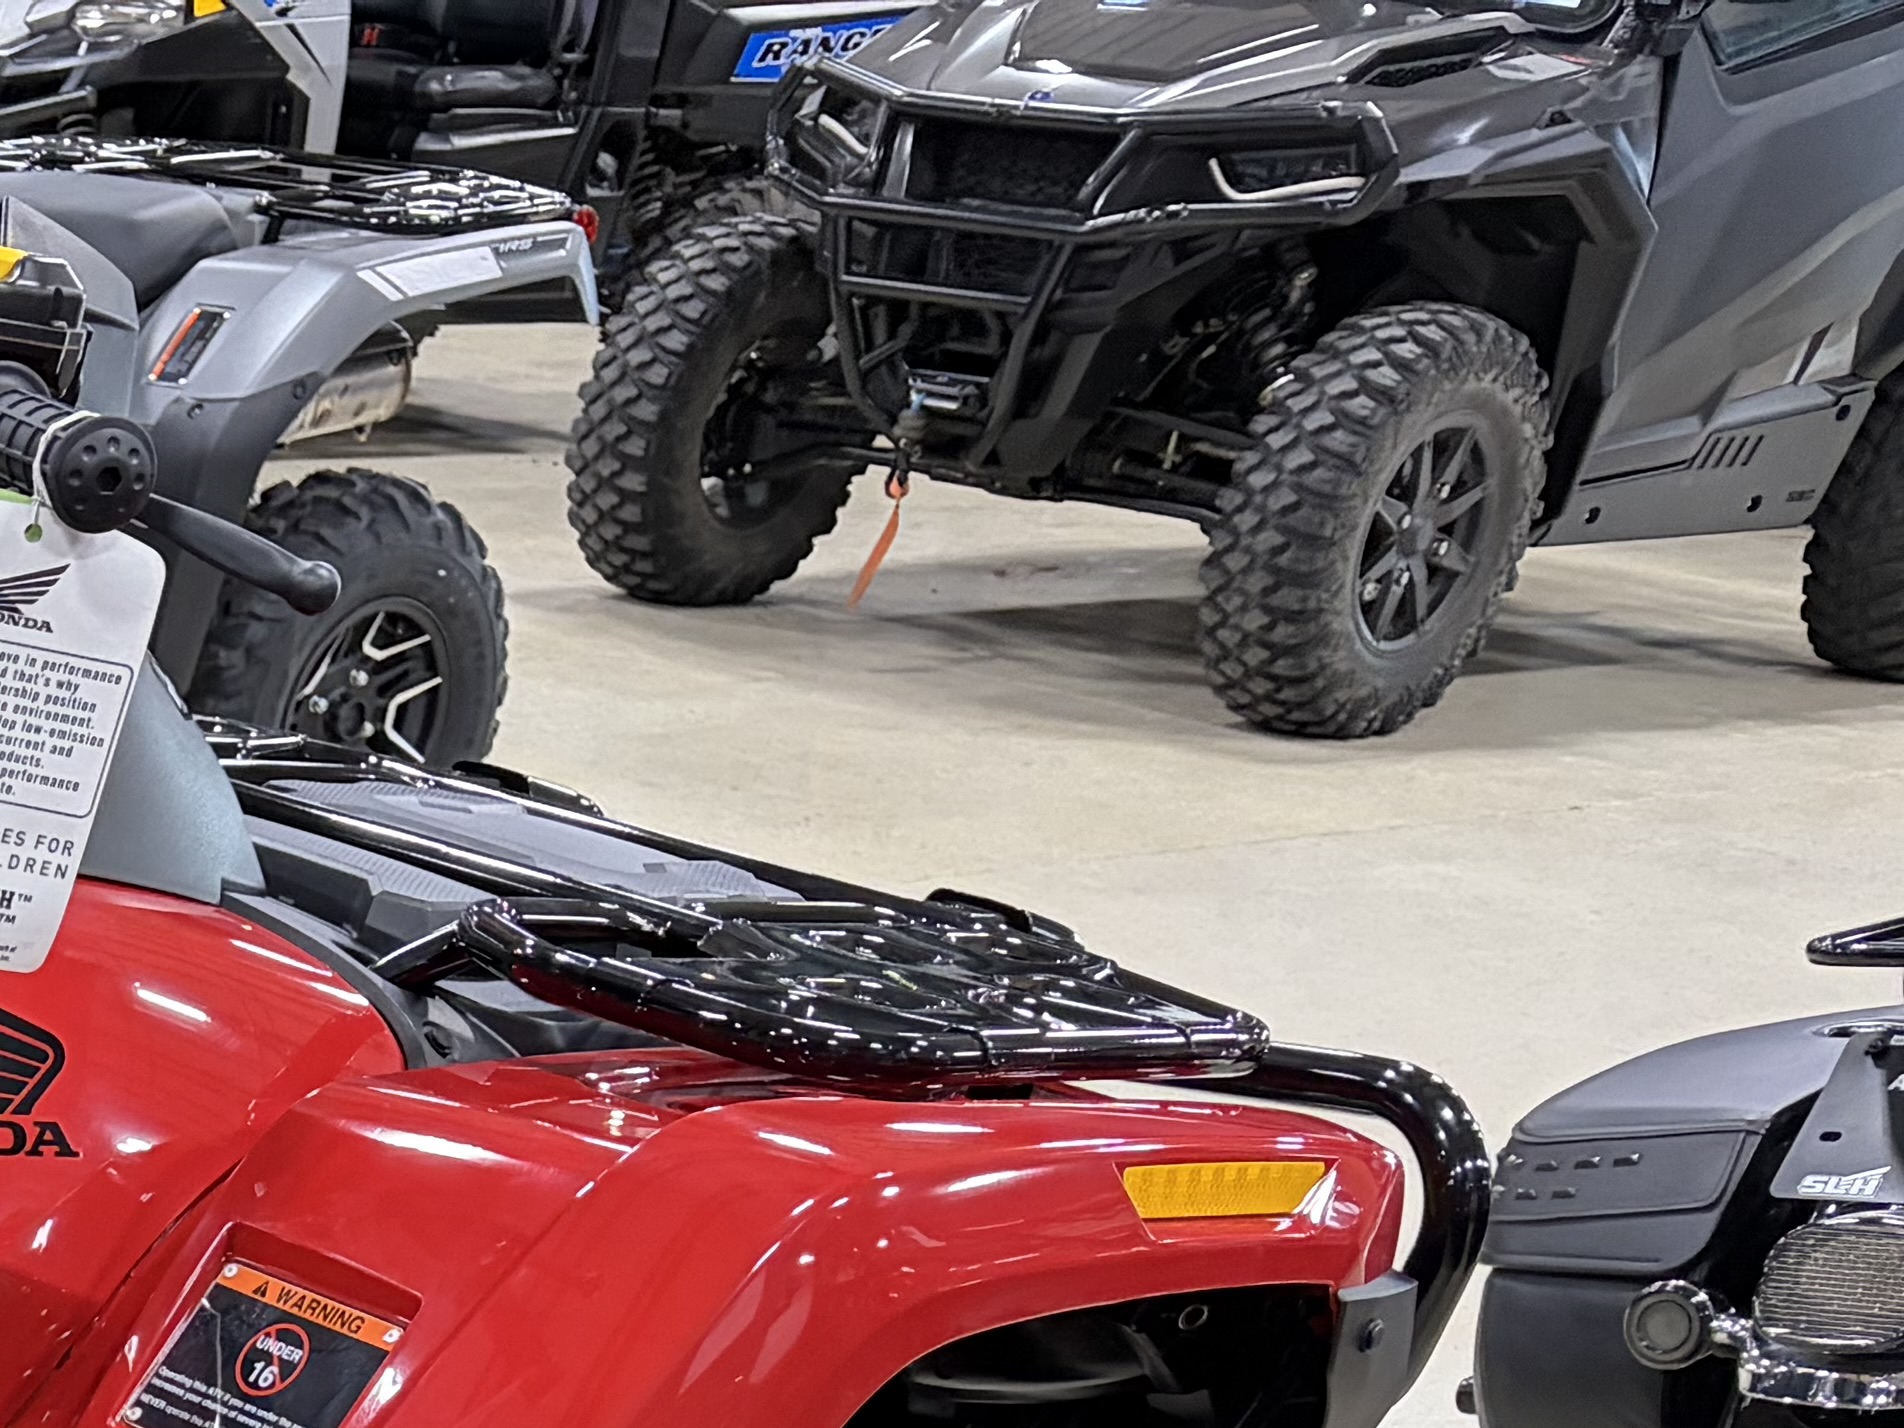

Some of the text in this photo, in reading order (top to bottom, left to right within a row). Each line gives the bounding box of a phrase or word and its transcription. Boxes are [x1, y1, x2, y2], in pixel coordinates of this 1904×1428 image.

[12, 669, 52, 688] that's
[55, 679, 81, 696] why
[24, 653, 38, 668] in
[40, 659, 122, 686] performance
[12, 703, 94, 730] environment.
[43, 693, 97, 714] position
[21, 719, 105, 748] low-emission
[49, 744, 74, 758] and
[33, 834, 75, 857] FOR
[276, 1286, 366, 1335] WARNING
[256, 1334, 304, 1364] UNDER
[248, 1361, 280, 1388] 16
